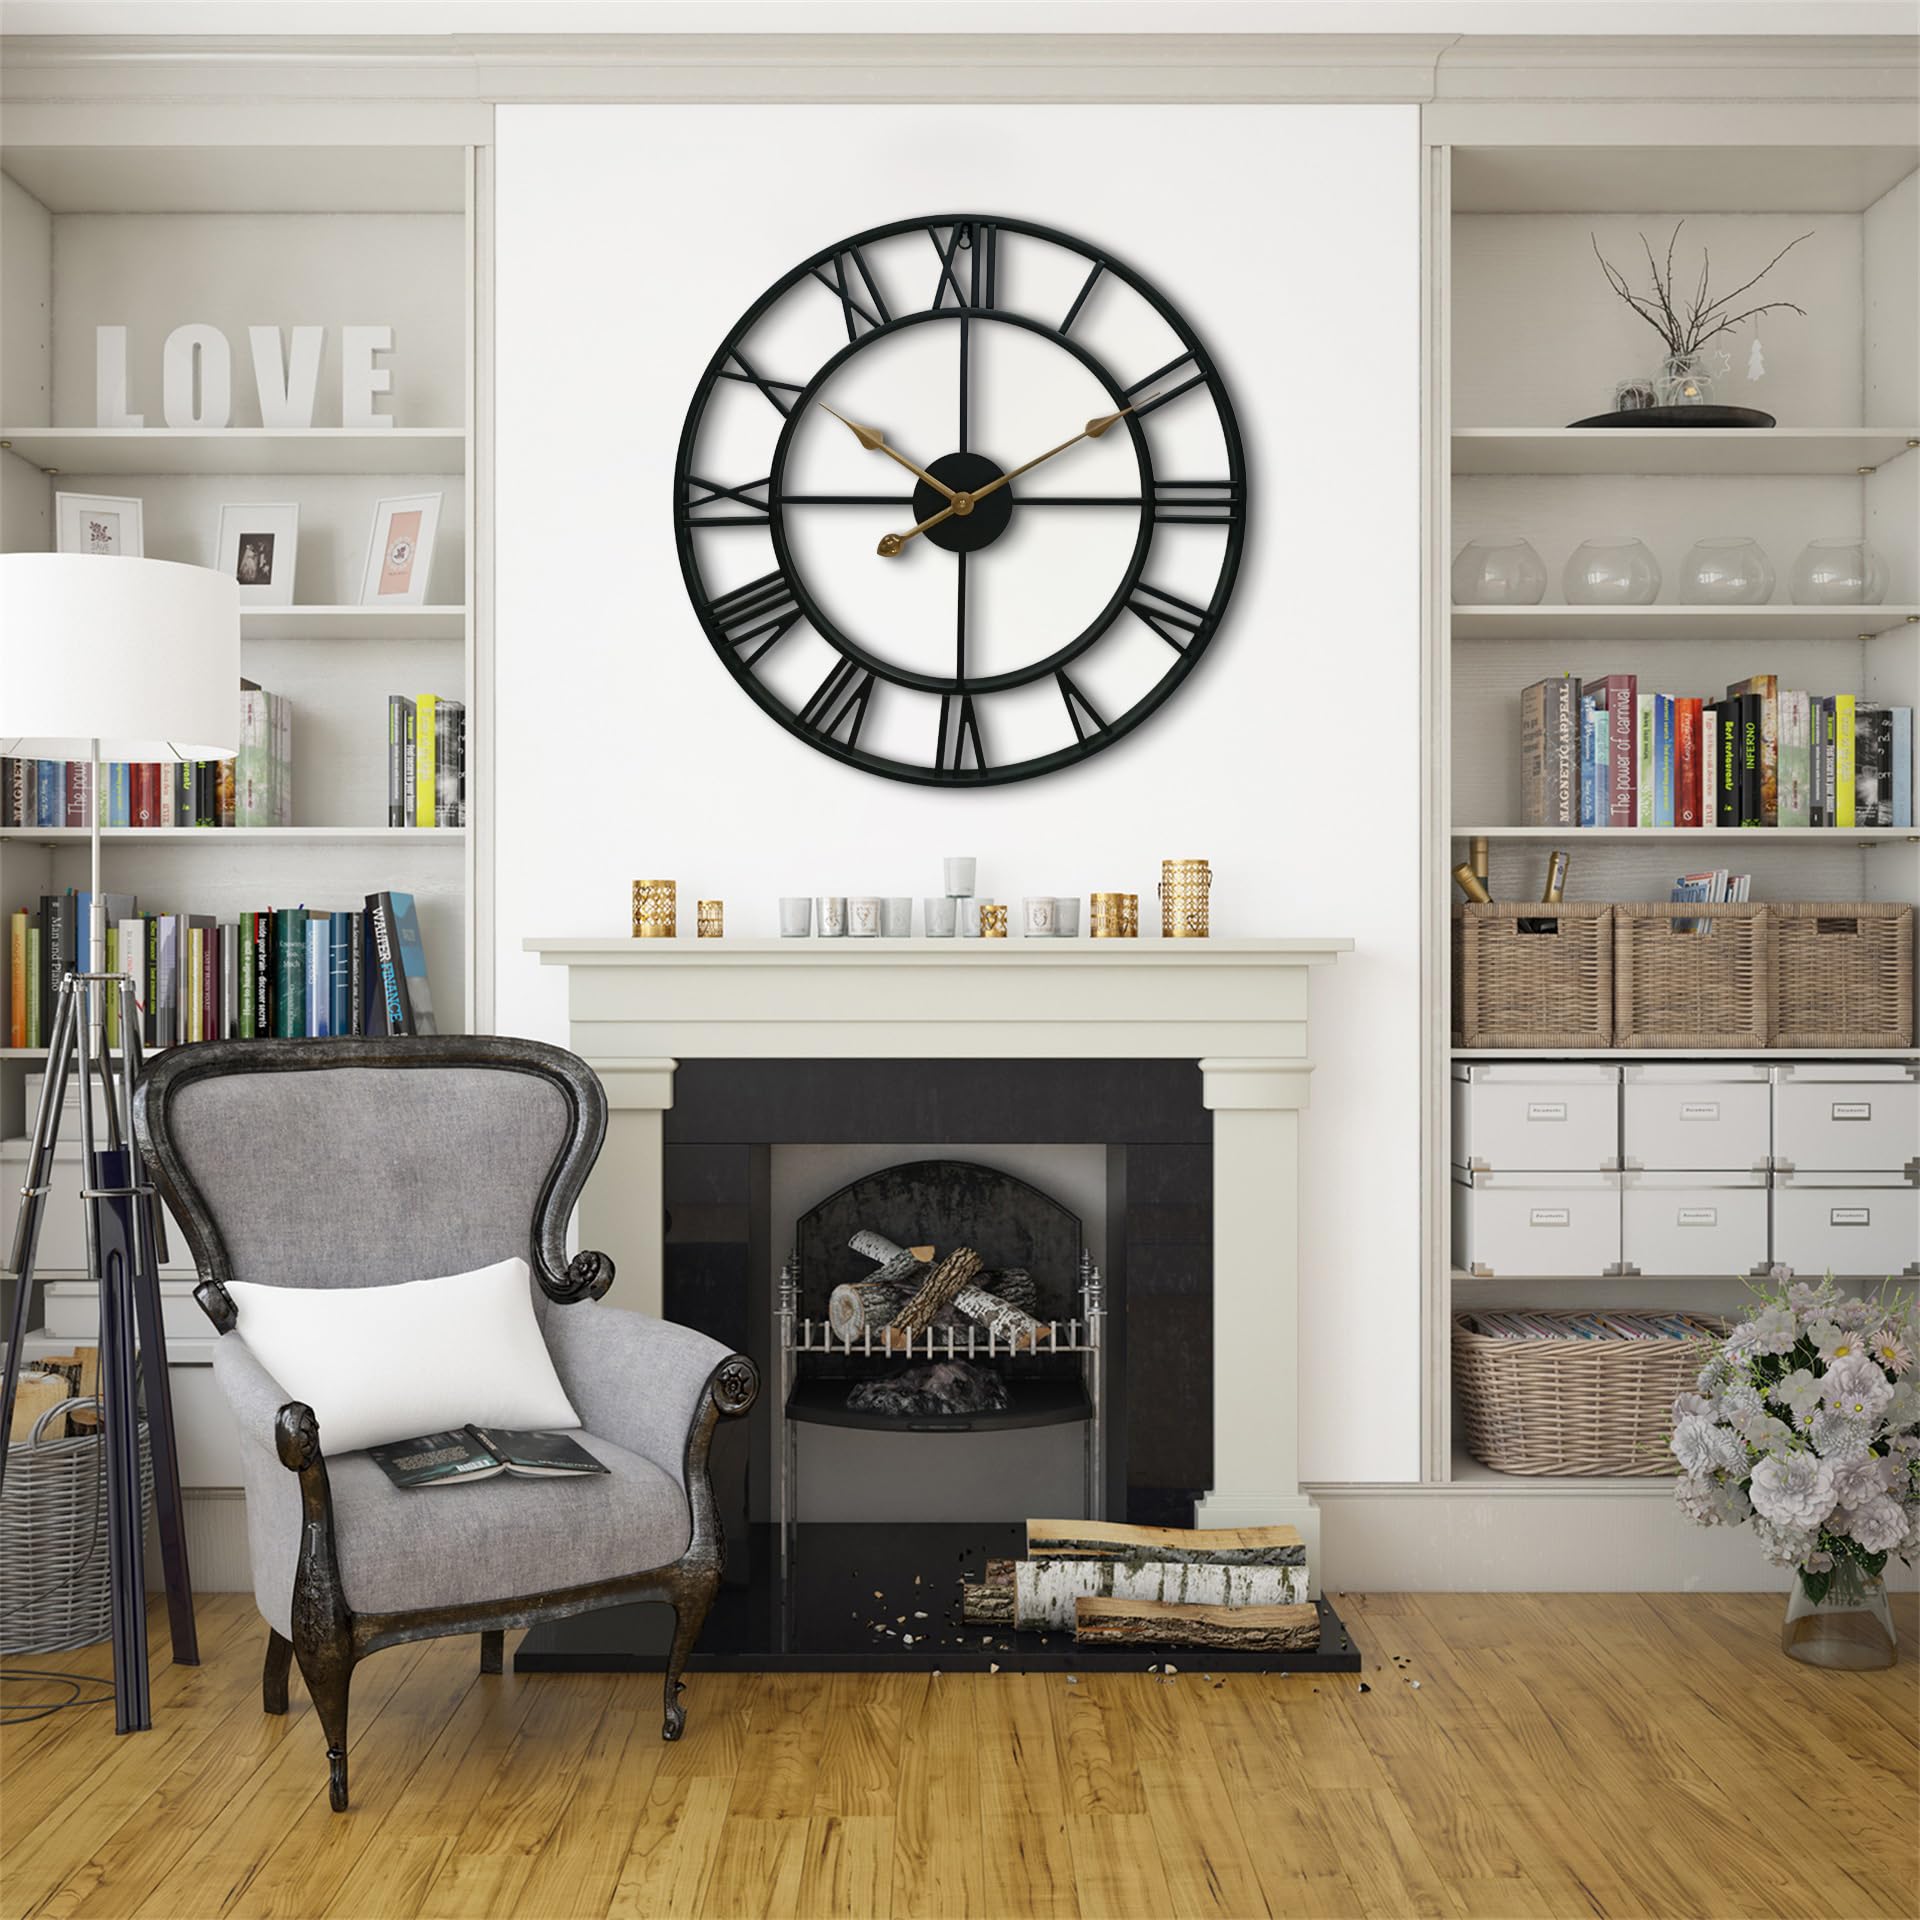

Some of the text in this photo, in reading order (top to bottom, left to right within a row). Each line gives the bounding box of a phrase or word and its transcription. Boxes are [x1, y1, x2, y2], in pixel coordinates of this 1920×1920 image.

[809, 244, 892, 342] XI
[928, 224, 997, 310] XII
[96, 323, 394, 428] LOVE
[714, 345, 805, 419] X
[1123, 348, 1209, 417] II
[683, 474, 772, 527] IX
[1153, 480, 1238, 524] III
[701, 569, 803, 669] VIII
[1126, 581, 1214, 656] IV
[793, 654, 878, 752] VII
[934, 693, 987, 777] VI
[1054, 669, 1113, 748] V
[1560, 683, 1570, 823] MAGNETIC APPEAL
[1611, 688, 1636, 816] The power of carnival
[1724, 721, 1734, 791] Best restaurants
[1745, 722, 1755, 769] INFERNO
[13, 760, 24, 821] MAGNET
[67, 789, 87, 816] The
[51, 917, 62, 991] Man and Piano
[257, 938, 266, 954] your
[259, 918, 268, 937] Inside
[372, 905, 391, 962] WALTER
[259, 954, 267, 971] brain
[259, 976, 267, 1003] discover
[381, 961, 403, 1022] FINANCE
[259, 1004, 267, 1028] secrets
